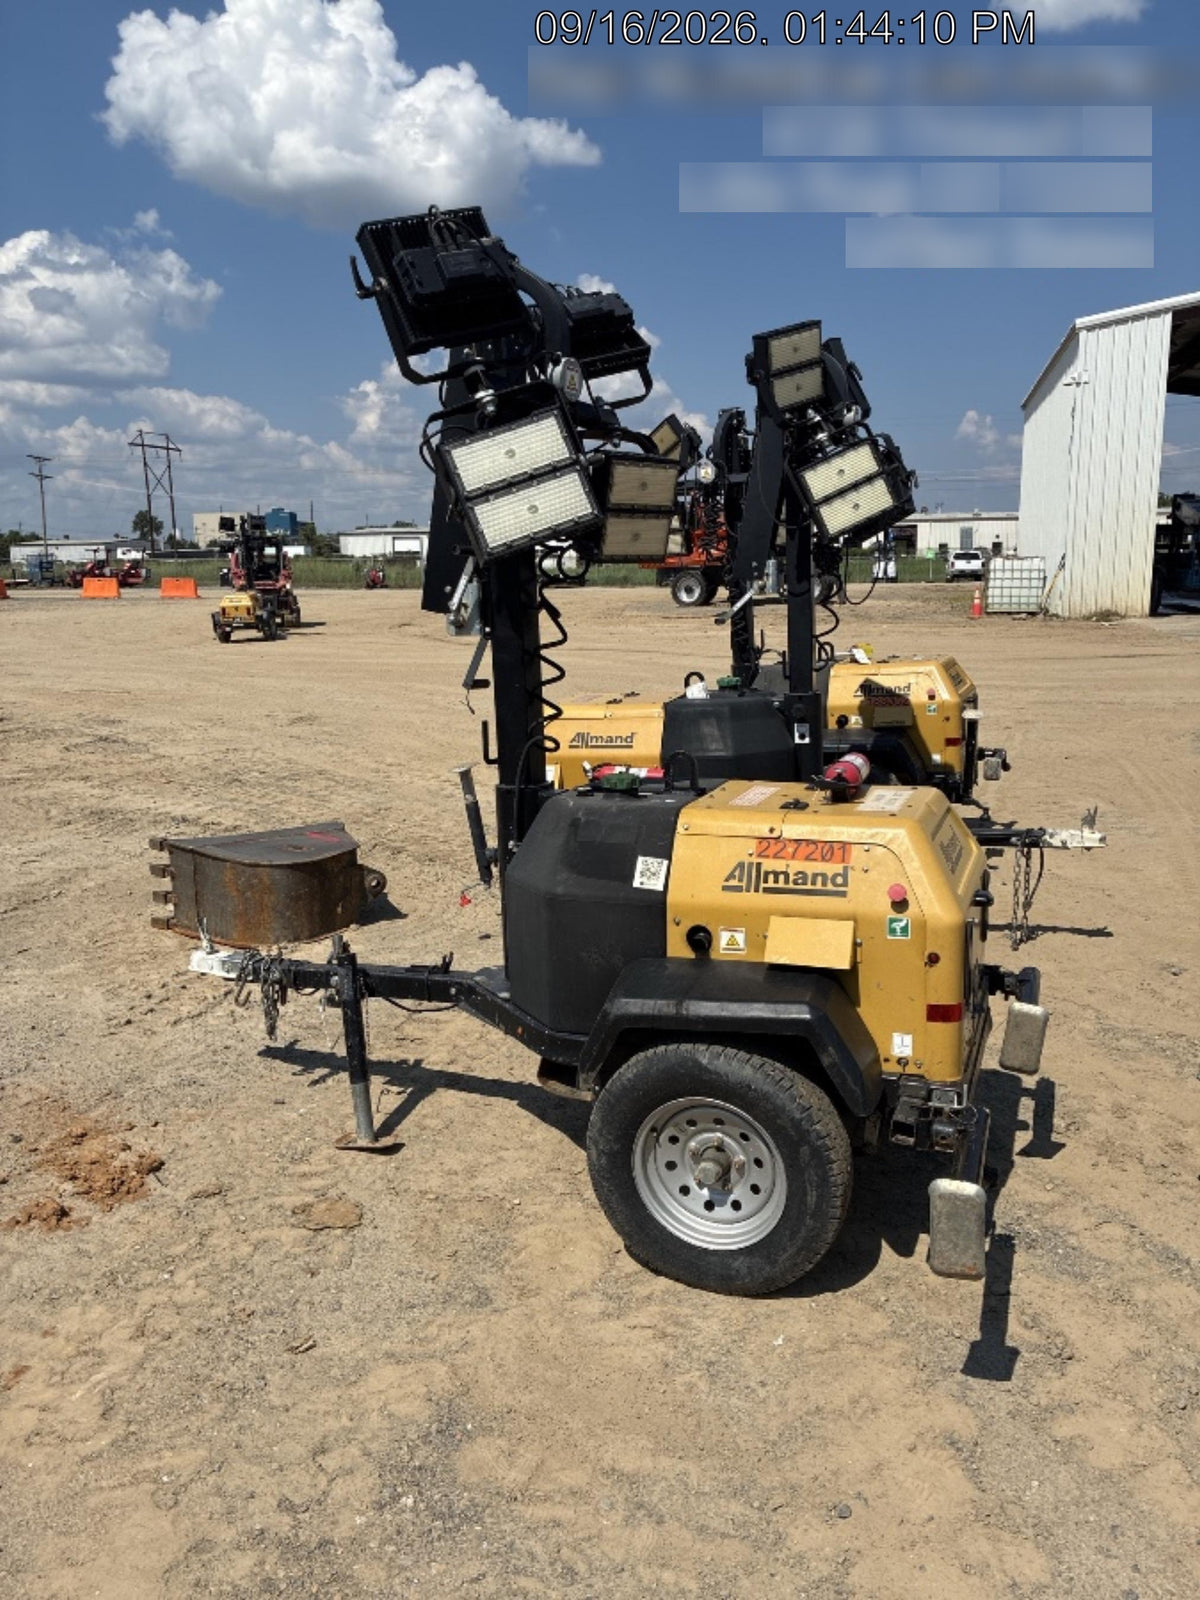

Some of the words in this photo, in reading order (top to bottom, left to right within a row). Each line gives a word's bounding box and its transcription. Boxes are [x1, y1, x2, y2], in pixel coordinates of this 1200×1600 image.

[854, 681, 911, 698] Allmand
[568, 732, 634, 749] Allmand
[756, 839, 848, 863] 227201
[721, 861, 849, 897] Allmand
